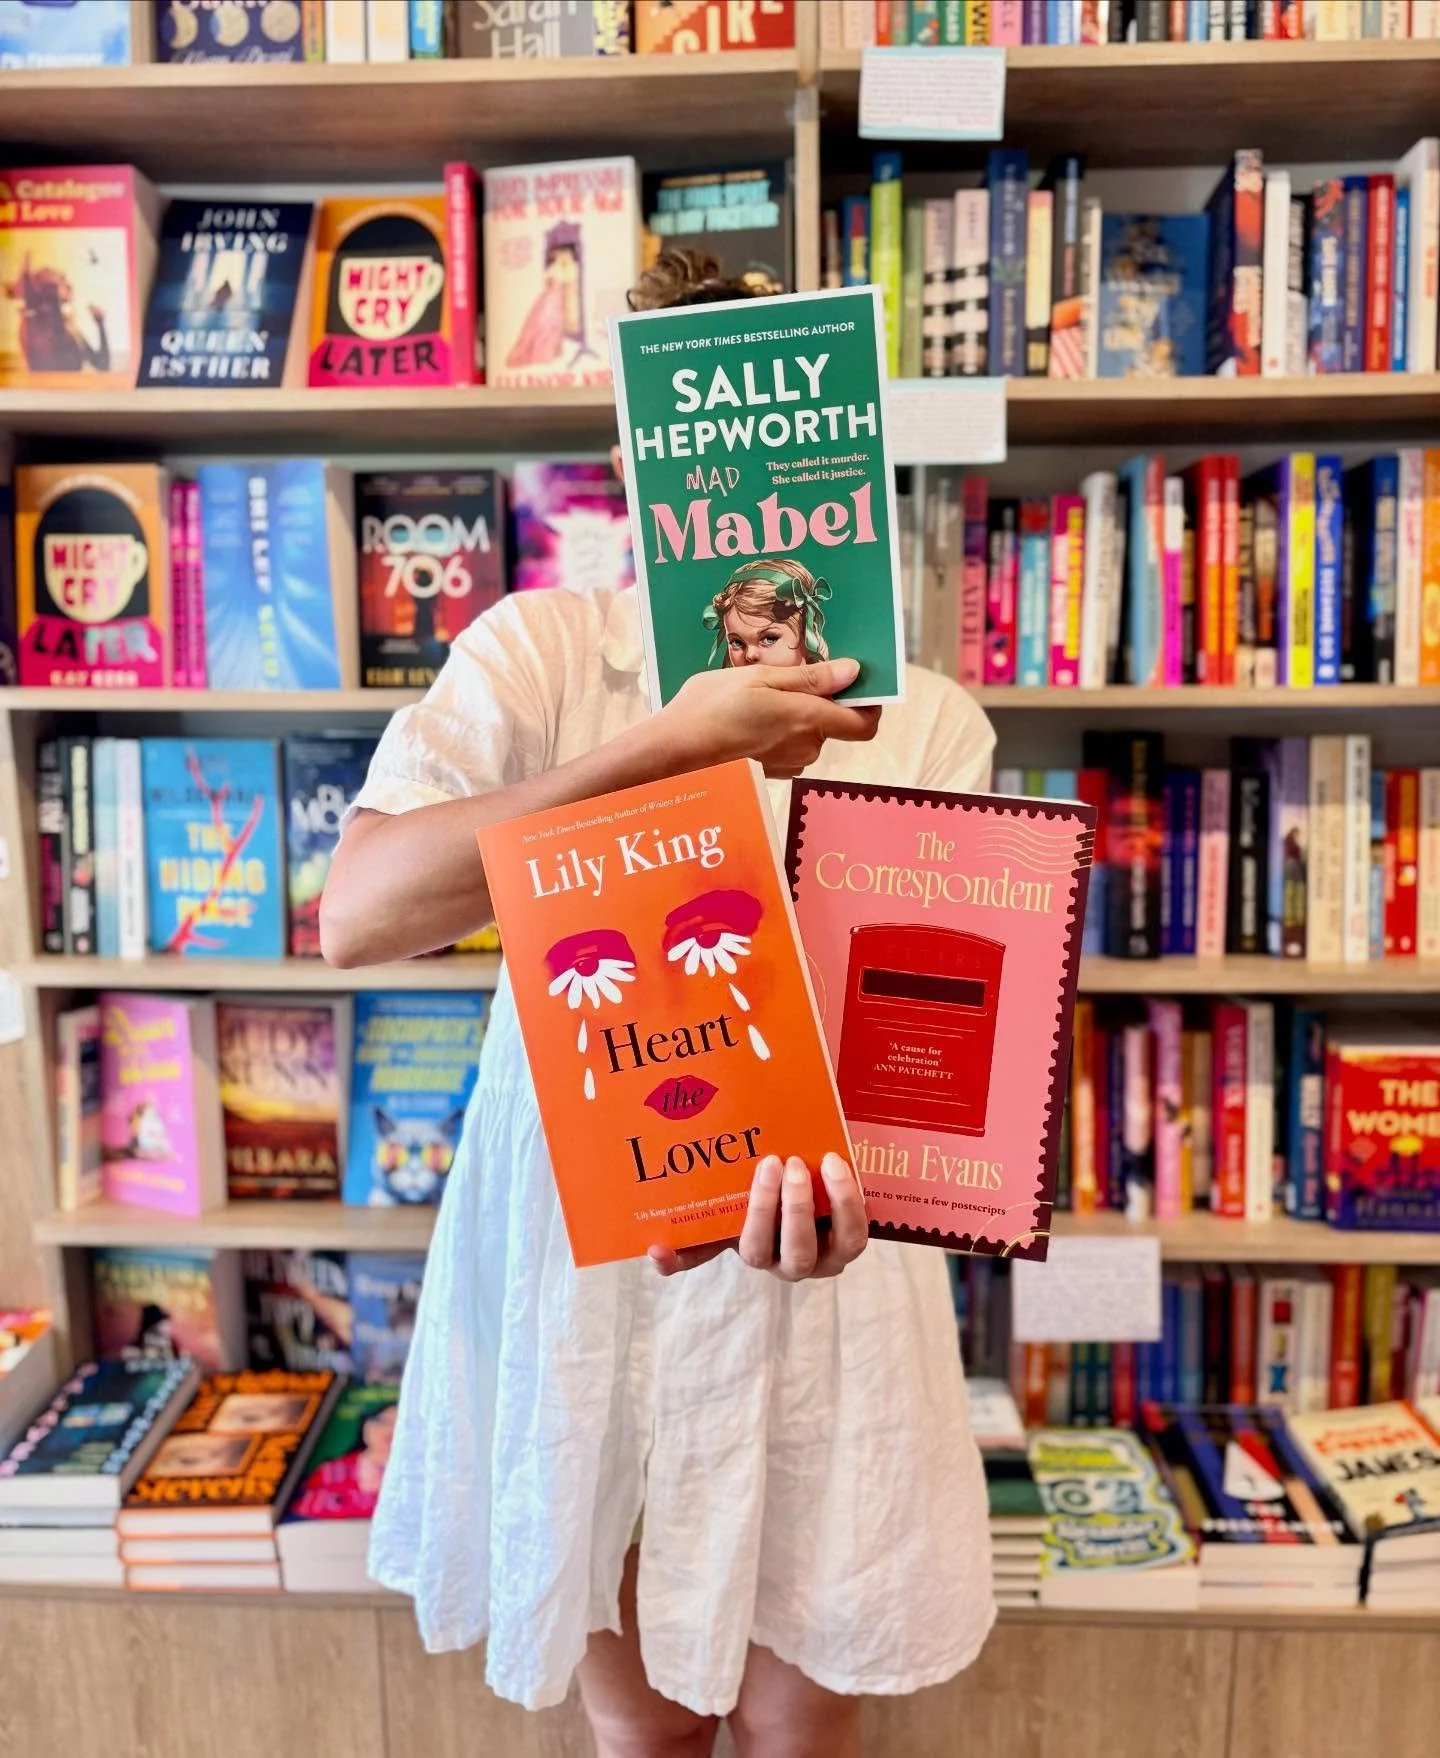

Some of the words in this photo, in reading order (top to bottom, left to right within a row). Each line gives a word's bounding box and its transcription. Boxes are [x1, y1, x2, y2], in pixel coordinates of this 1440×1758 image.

[491, 22, 561, 58] Hall
[21, 203, 75, 221] Love
[199, 207, 280, 229] JOHN
[181, 231, 288, 253] IRVING
[347, 263, 425, 291] MIGHT
[354, 297, 413, 329] CRY
[160, 330, 269, 354] QUEEN
[640, 344, 660, 356] THE
[662, 341, 683, 353] NEW
[685, 337, 712, 351] YORK
[714, 334, 742, 347] TIMES
[743, 325, 810, 343] BESTSELLING
[811, 321, 855, 336] AUTHOR
[149, 355, 270, 380] ESTHER
[319, 341, 439, 377] LATER
[672, 353, 830, 413] SALLY
[635, 402, 877, 461] HEPWORTH
[766, 460, 790, 474] They
[792, 456, 822, 470] called
[822, 455, 830, 466] it
[831, 452, 870, 466] murder.
[772, 474, 788, 485] She
[790, 470, 821, 484] called
[821, 470, 829, 480] it
[828, 466, 866, 482] justice.
[686, 464, 740, 497] MAD
[361, 514, 491, 556] ROOM
[649, 481, 878, 564] Mabel
[63, 577, 119, 608] CRY
[381, 555, 473, 599] 706
[32, 624, 158, 666] LATER
[575, 813, 614, 830] Bestselling
[614, 808, 639, 821] Author
[639, 804, 648, 815] of
[525, 849, 606, 898] Lily
[615, 824, 724, 876] King
[916, 830, 956, 862] The
[815, 851, 1054, 914] Correspondent
[600, 1013, 740, 1074] Heart
[901, 1044, 926, 1054] cause
[928, 1046, 943, 1056] for
[873, 1063, 897, 1072] ANN
[898, 1065, 954, 1080] PATCHETT
[663, 1081, 704, 1113] the
[1378, 1078, 1439, 1108] THE
[626, 1126, 761, 1183] Lover
[920, 1144, 1004, 1191] Evans
[670, 1207, 718, 1226] MADELINE
[719, 1201, 751, 1216] MILLE
[674, 1203, 687, 1213] one
[687, 1200, 695, 1211] of
[695, 1200, 708, 1208] our
[708, 1195, 725, 1206] great
[863, 1187, 880, 1199] late
[883, 1191, 893, 1200] to
[895, 1192, 922, 1204] write
[923, 1197, 929, 1205] a
[931, 1196, 949, 1208] few
[951, 1200, 1007, 1217] postscripts
